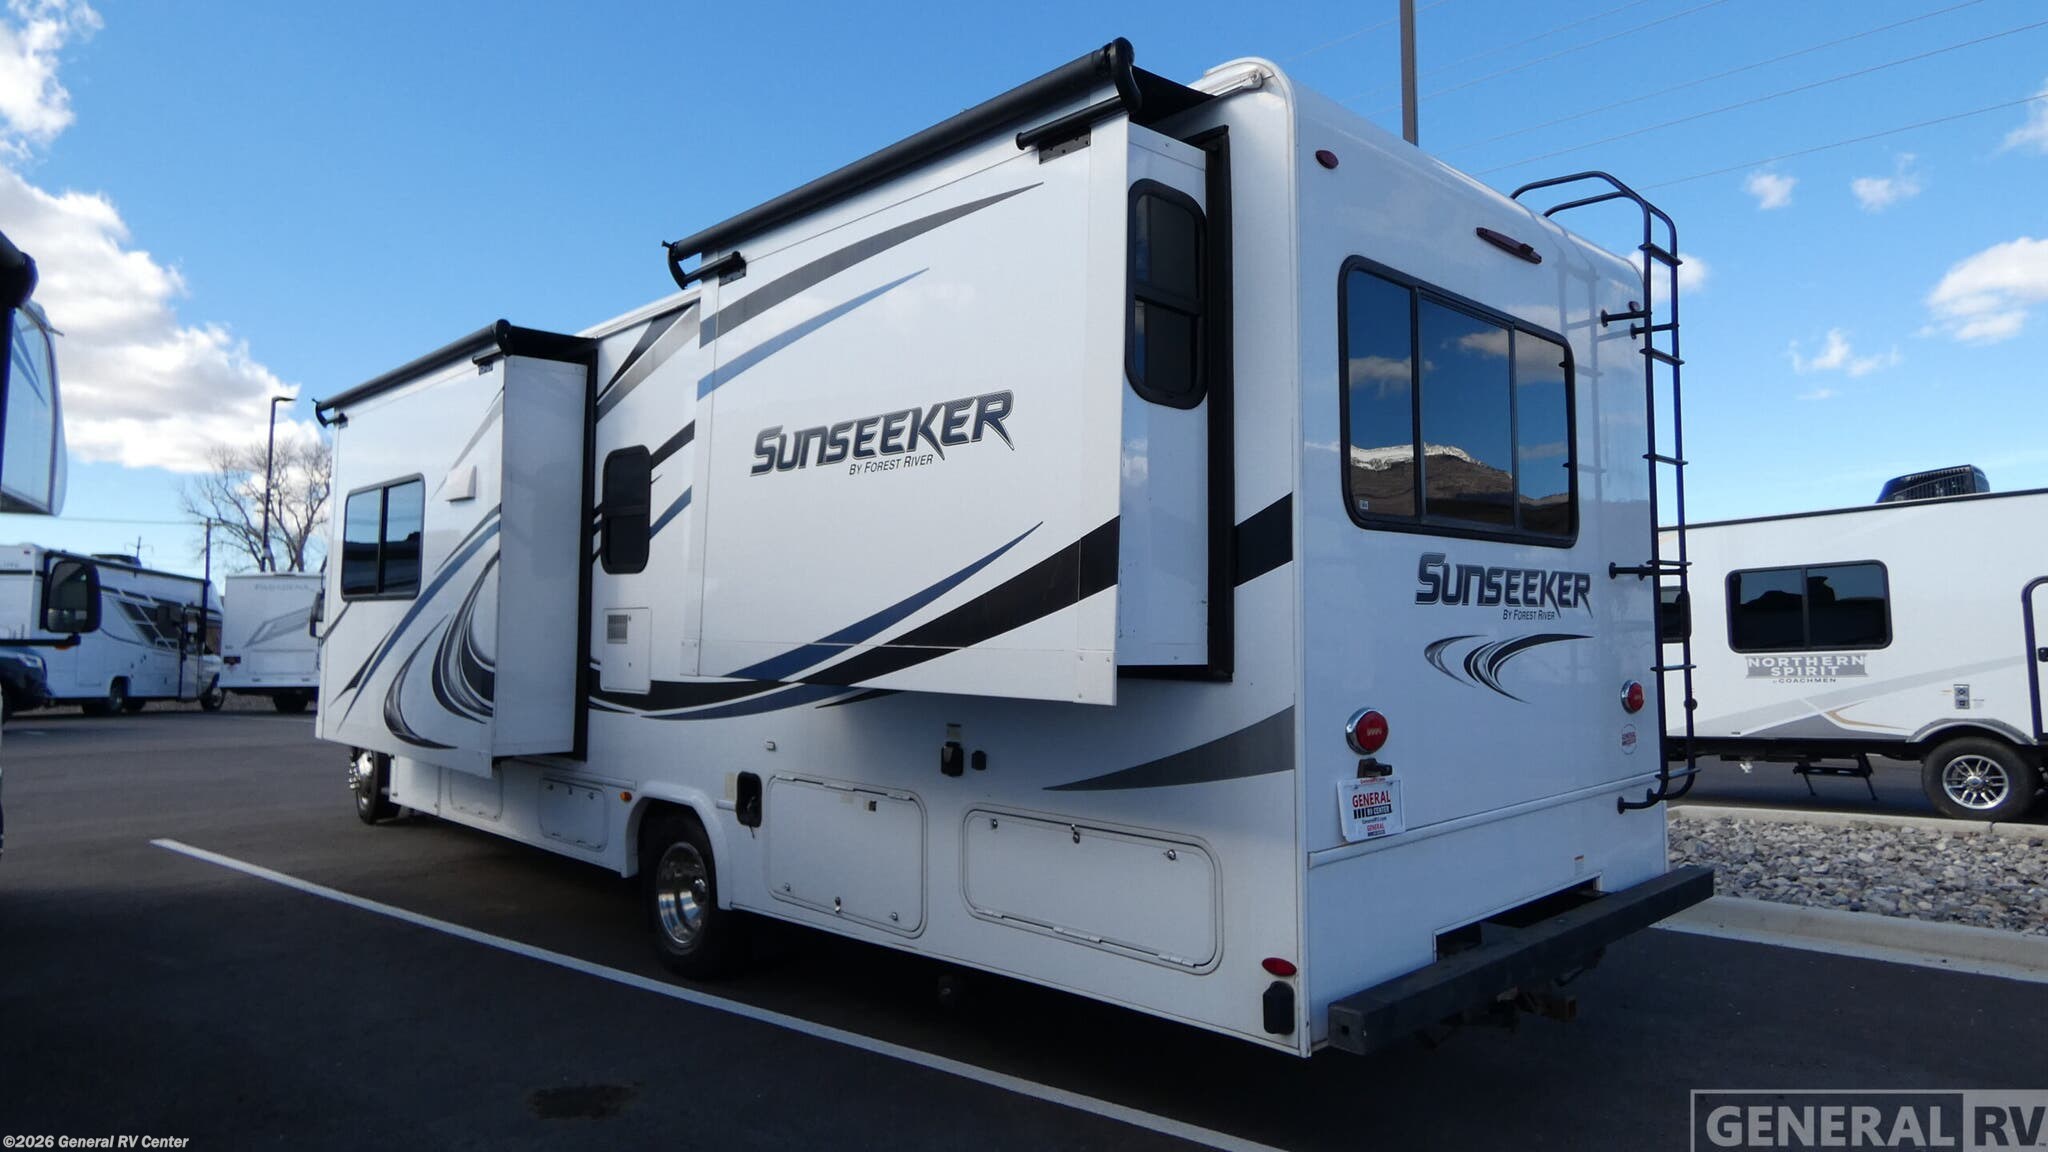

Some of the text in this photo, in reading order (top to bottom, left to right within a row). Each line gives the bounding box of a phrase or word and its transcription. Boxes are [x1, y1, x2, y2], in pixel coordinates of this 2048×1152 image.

[749, 389, 1015, 477] SUNSEEKER
[864, 459, 901, 473] FOREST
[904, 454, 933, 468] RIVER
[1415, 552, 1593, 619] SUNSEEKER
[1513, 609, 1536, 620] FOREST
[1538, 609, 1555, 620] RIVER
[1748, 655, 1865, 668] NORTHERN
[1770, 666, 1840, 676] SPIRIT
[1352, 790, 1391, 808] GENERAL
